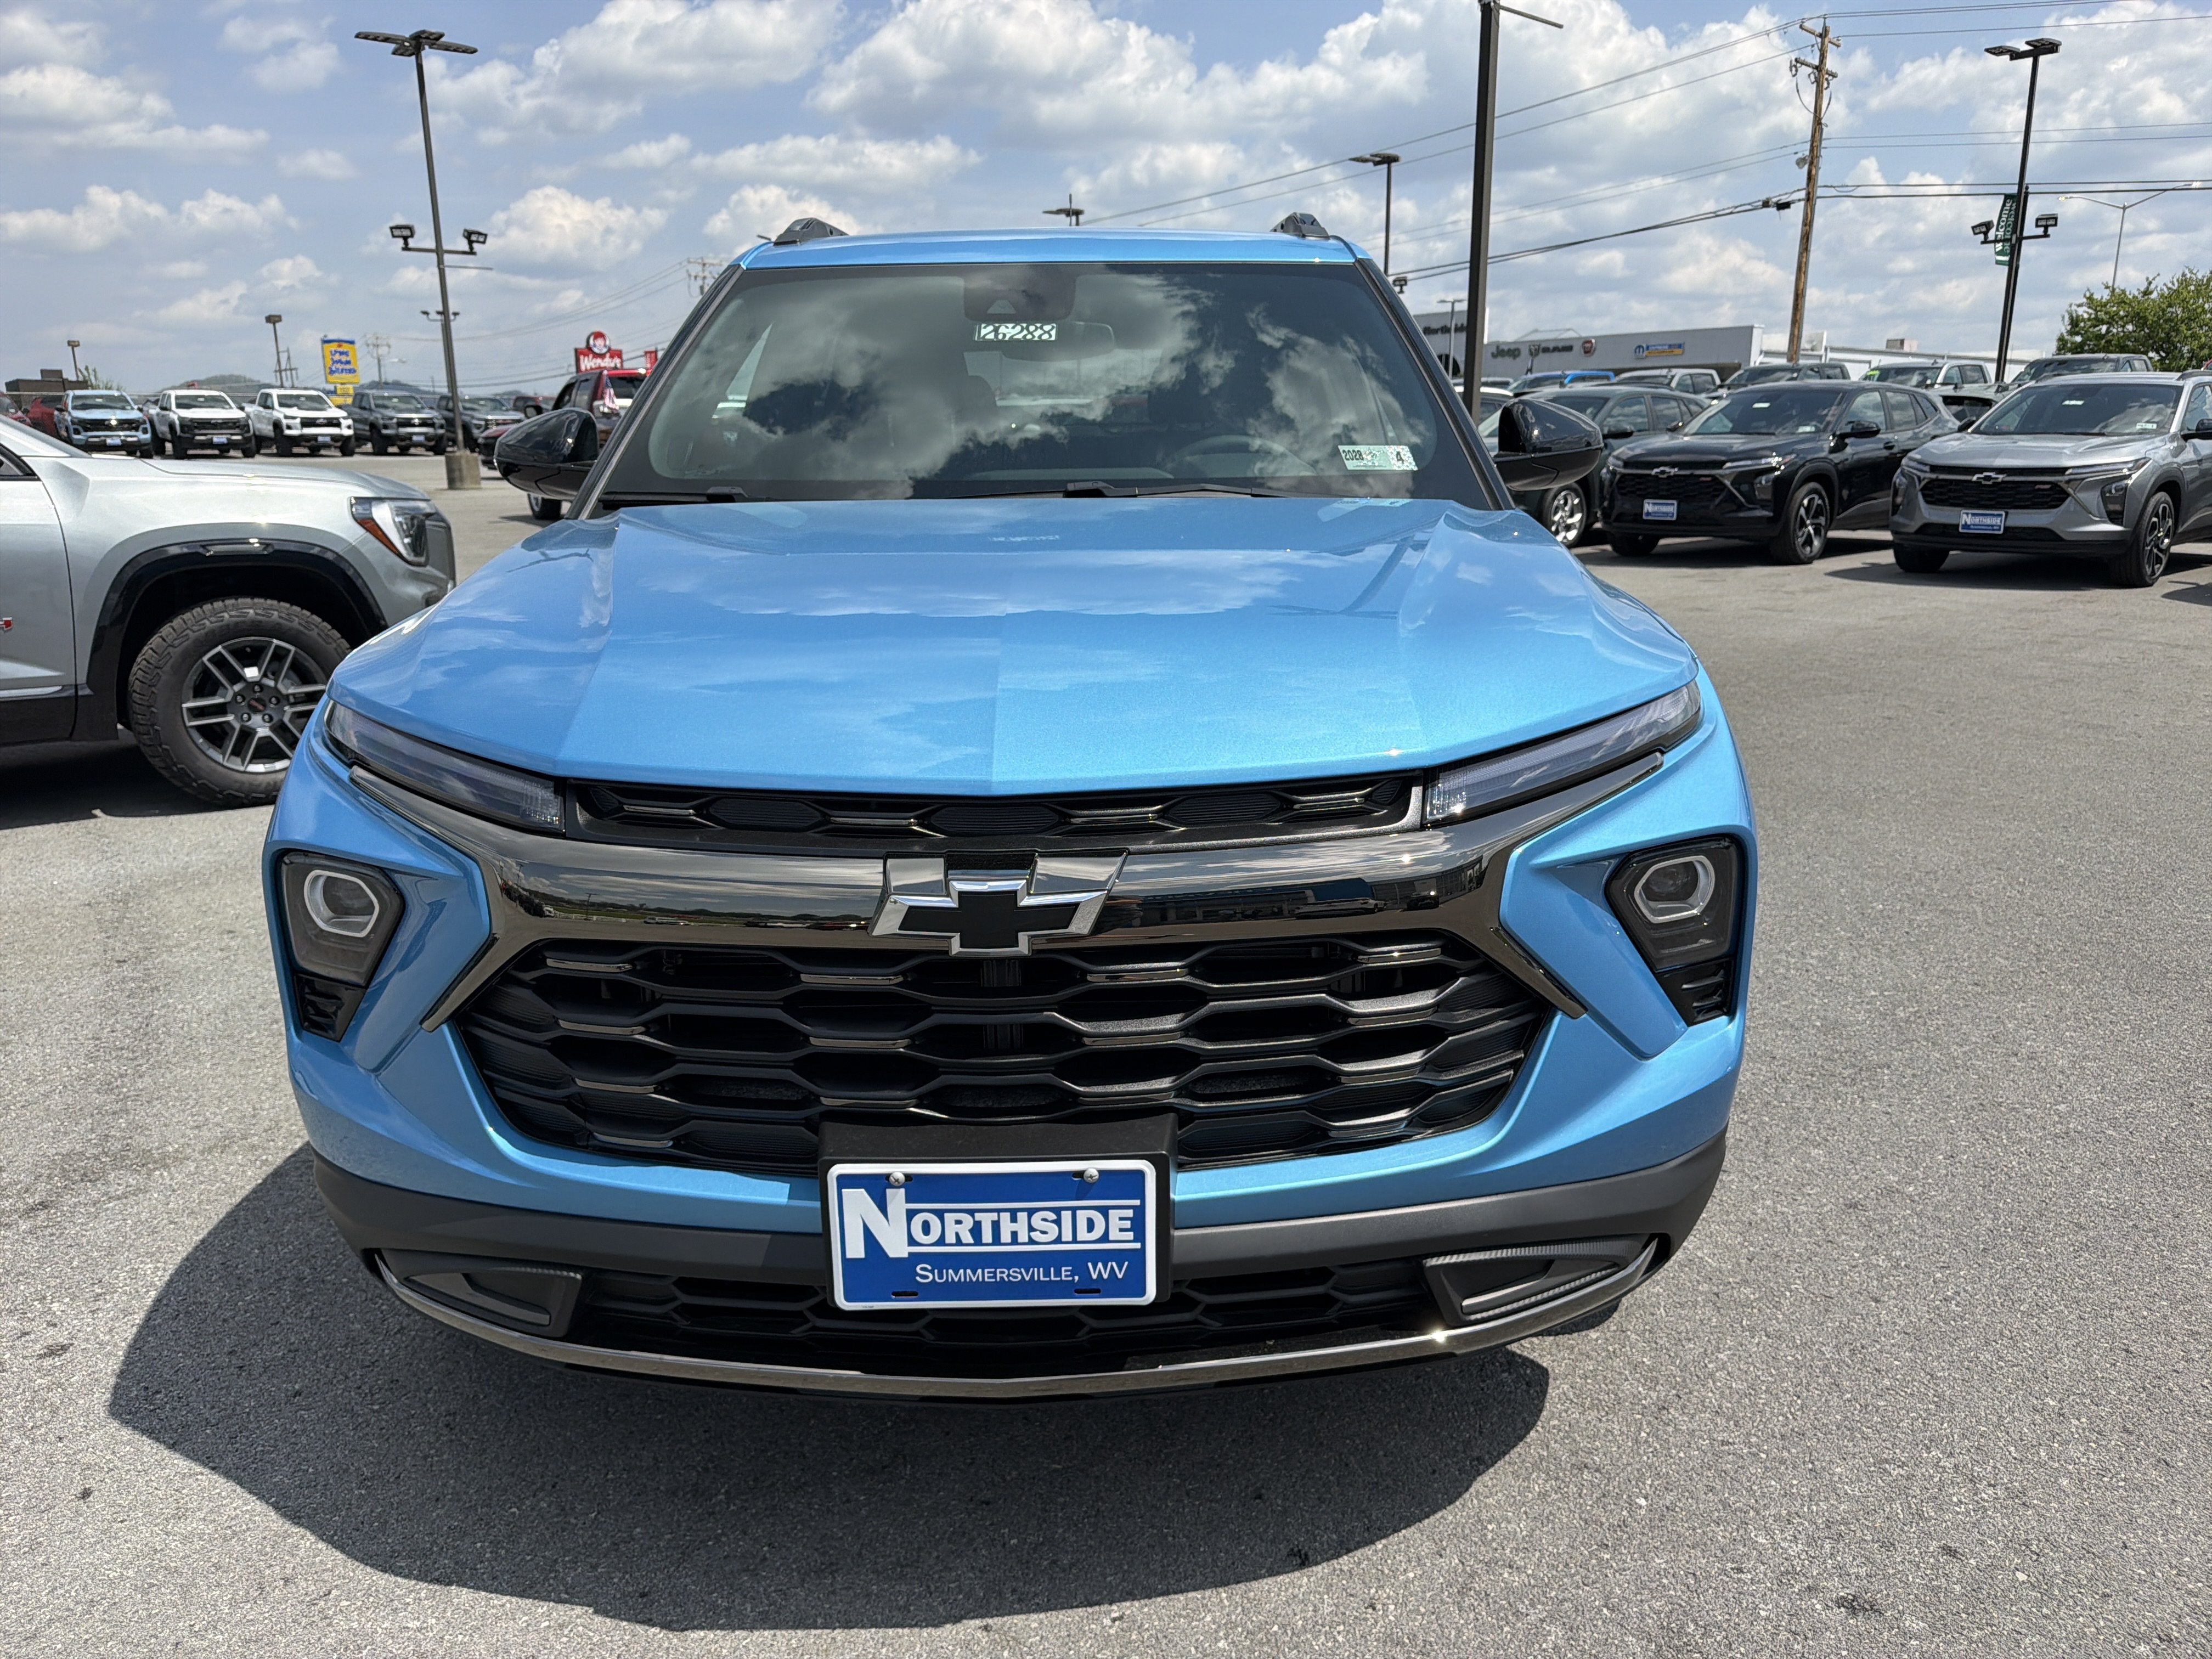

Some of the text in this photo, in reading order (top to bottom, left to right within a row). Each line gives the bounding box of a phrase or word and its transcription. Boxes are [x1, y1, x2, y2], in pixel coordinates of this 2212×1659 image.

[1491, 345, 1521, 360] Jeep
[579, 353, 622, 371] Wendy's
[1342, 449, 1404, 464] 2028 4
[842, 1188, 1134, 1259] NORTHSIDE
[915, 1261, 1128, 1283] SUMMERSVILLE, WV
